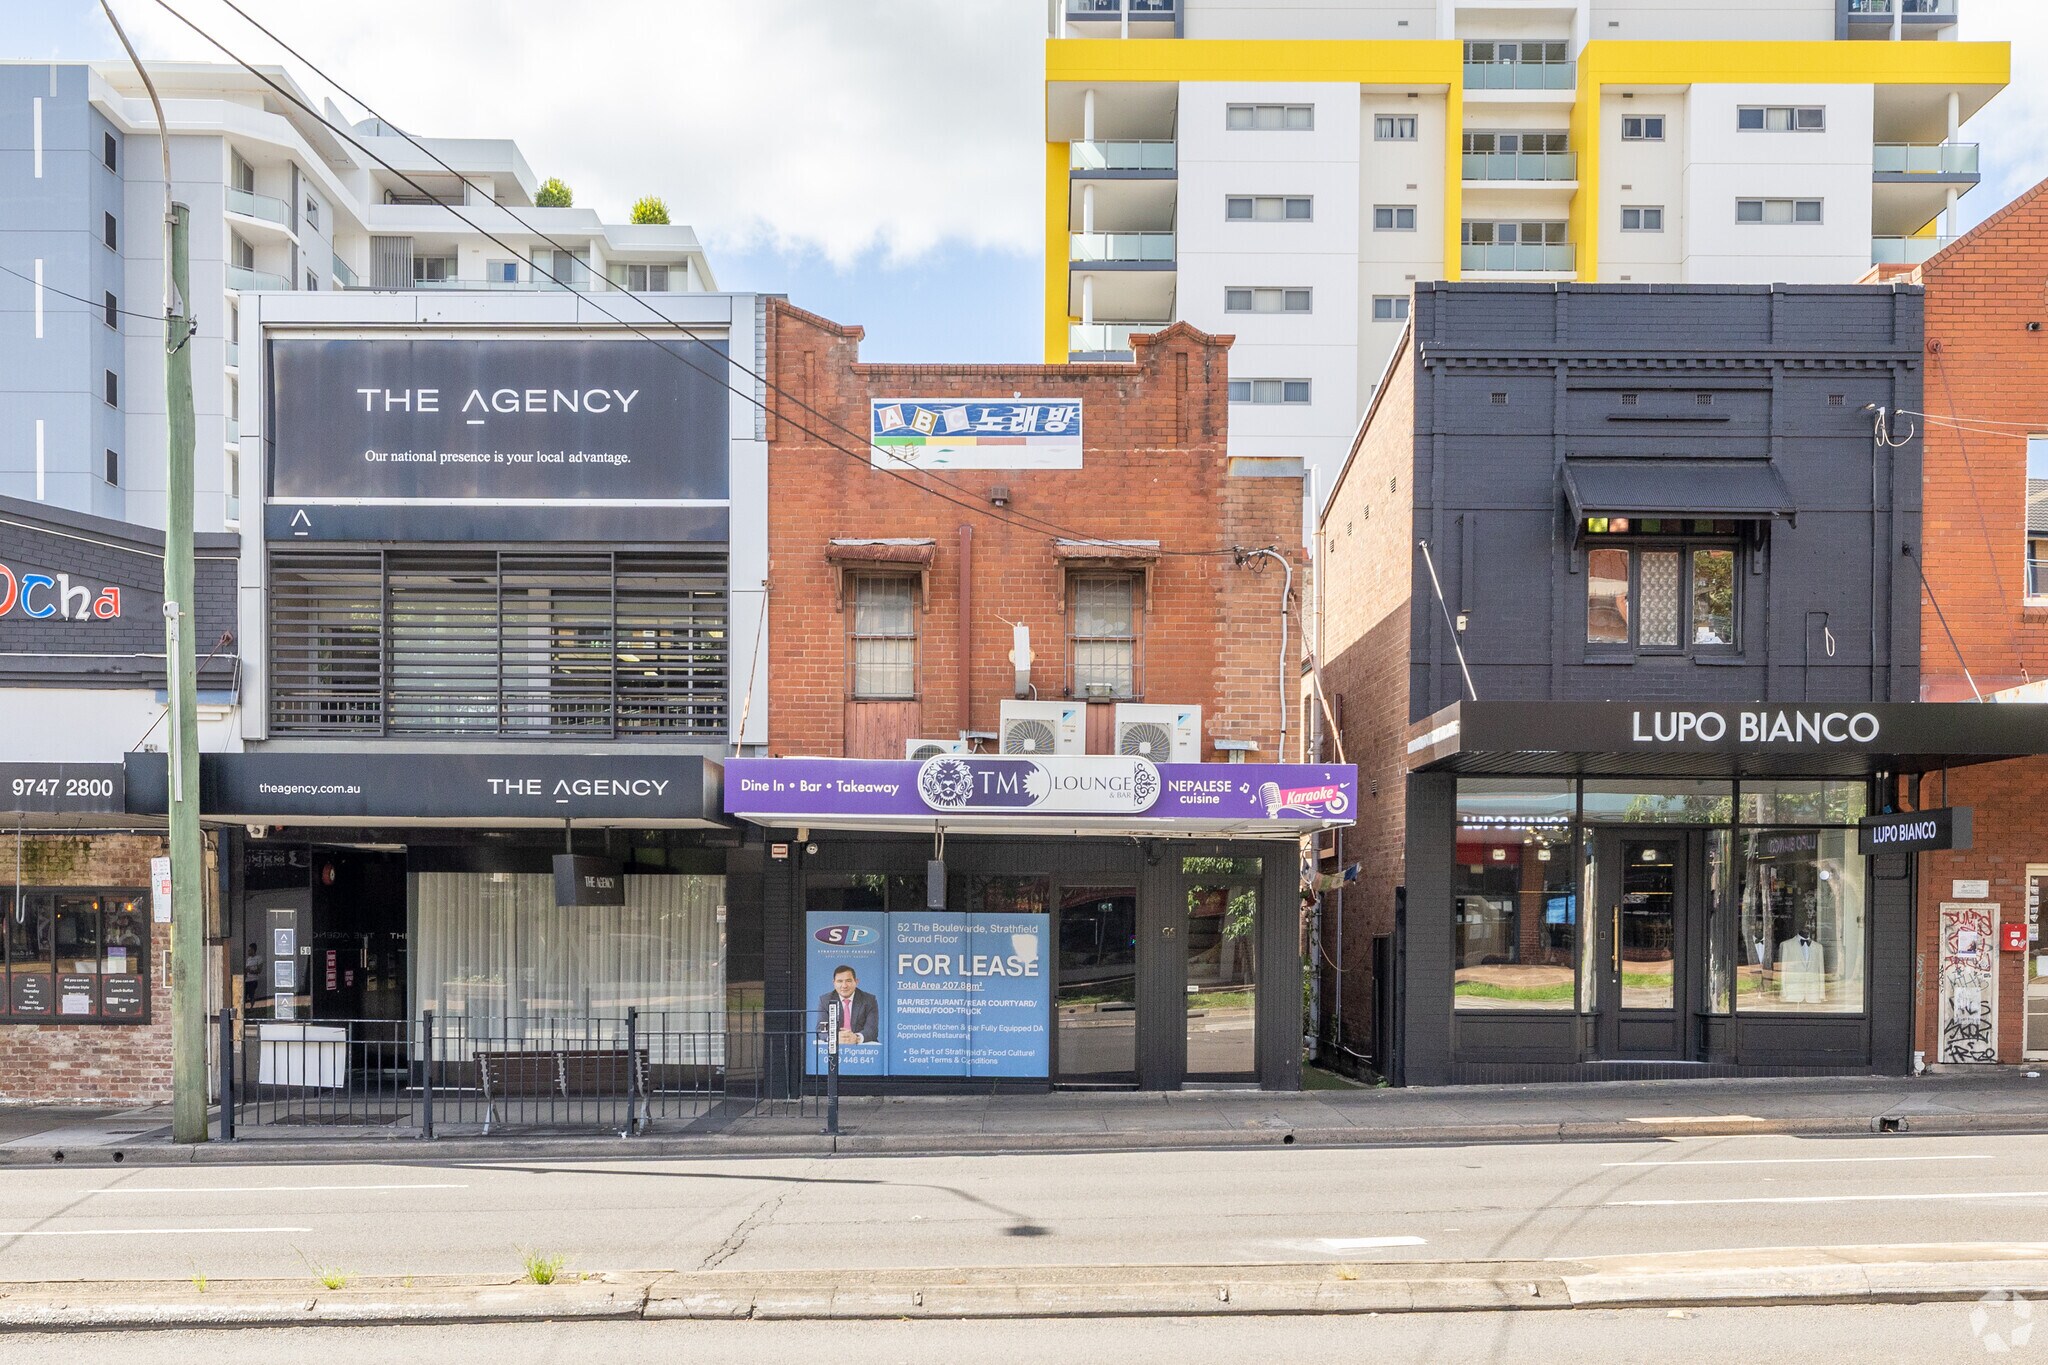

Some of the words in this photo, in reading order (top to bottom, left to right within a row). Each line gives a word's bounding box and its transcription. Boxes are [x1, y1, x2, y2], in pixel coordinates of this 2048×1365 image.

[357, 389, 439, 413] THE
[462, 389, 639, 424] AGENCY
[975, 404, 1079, 433] 노래방
[365, 450, 388, 463] Our
[391, 450, 437, 463] national
[440, 451, 490, 466] presence
[494, 450, 504, 463] is
[507, 451, 533, 466] your
[536, 450, 565, 463] local
[568, 450, 631, 465] advantage.
[1633, 711, 1727, 742] LUPO
[1740, 711, 1880, 743] BIANCO
[12, 779, 60, 796] 9747
[66, 779, 113, 797] 2800
[259, 782, 361, 796] theagency.com.au
[741, 779, 769, 792] Dine
[773, 780, 784, 791] In
[800, 780, 822, 792] Bar
[836, 780, 899, 796] Takeaway
[978, 771, 1018, 794] TM
[1054, 776, 1131, 791] LOUNGE
[1168, 780, 1231, 793] NEPALESE
[487, 779, 542, 795] THE
[553, 779, 669, 803] AGENCY
[1286, 787, 1334, 805] Karaoke
[1180, 793, 1220, 804] cuisine
[1873, 824, 1898, 843] LUPO
[1899, 820, 1937, 842] BIANCO
[828, 928, 869, 942] SP
[897, 922, 910, 932] 52
[912, 923, 930, 932] The
[932, 923, 988, 934] Boulevarde,
[990, 924, 1039, 933] Strathfield
[389, 932, 407, 940] TH
[897, 934, 932, 943] Ground
[934, 934, 958, 943] Floor
[898, 953, 951, 975] FOR
[958, 954, 1039, 976] LEASE
[897, 981, 919, 989] Total
[920, 981, 941, 989] Area
[897, 1007, 982, 1015] PARKING/FOOD-TRUCK
[988, 1000, 1038, 1008] COURTYARD/
[897, 1032, 931, 1040] Approved
[999, 1025, 1031, 1033] Equipped
[844, 1048, 879, 1056] Pignataro
[1008, 1049, 1036, 1057] Culture!
